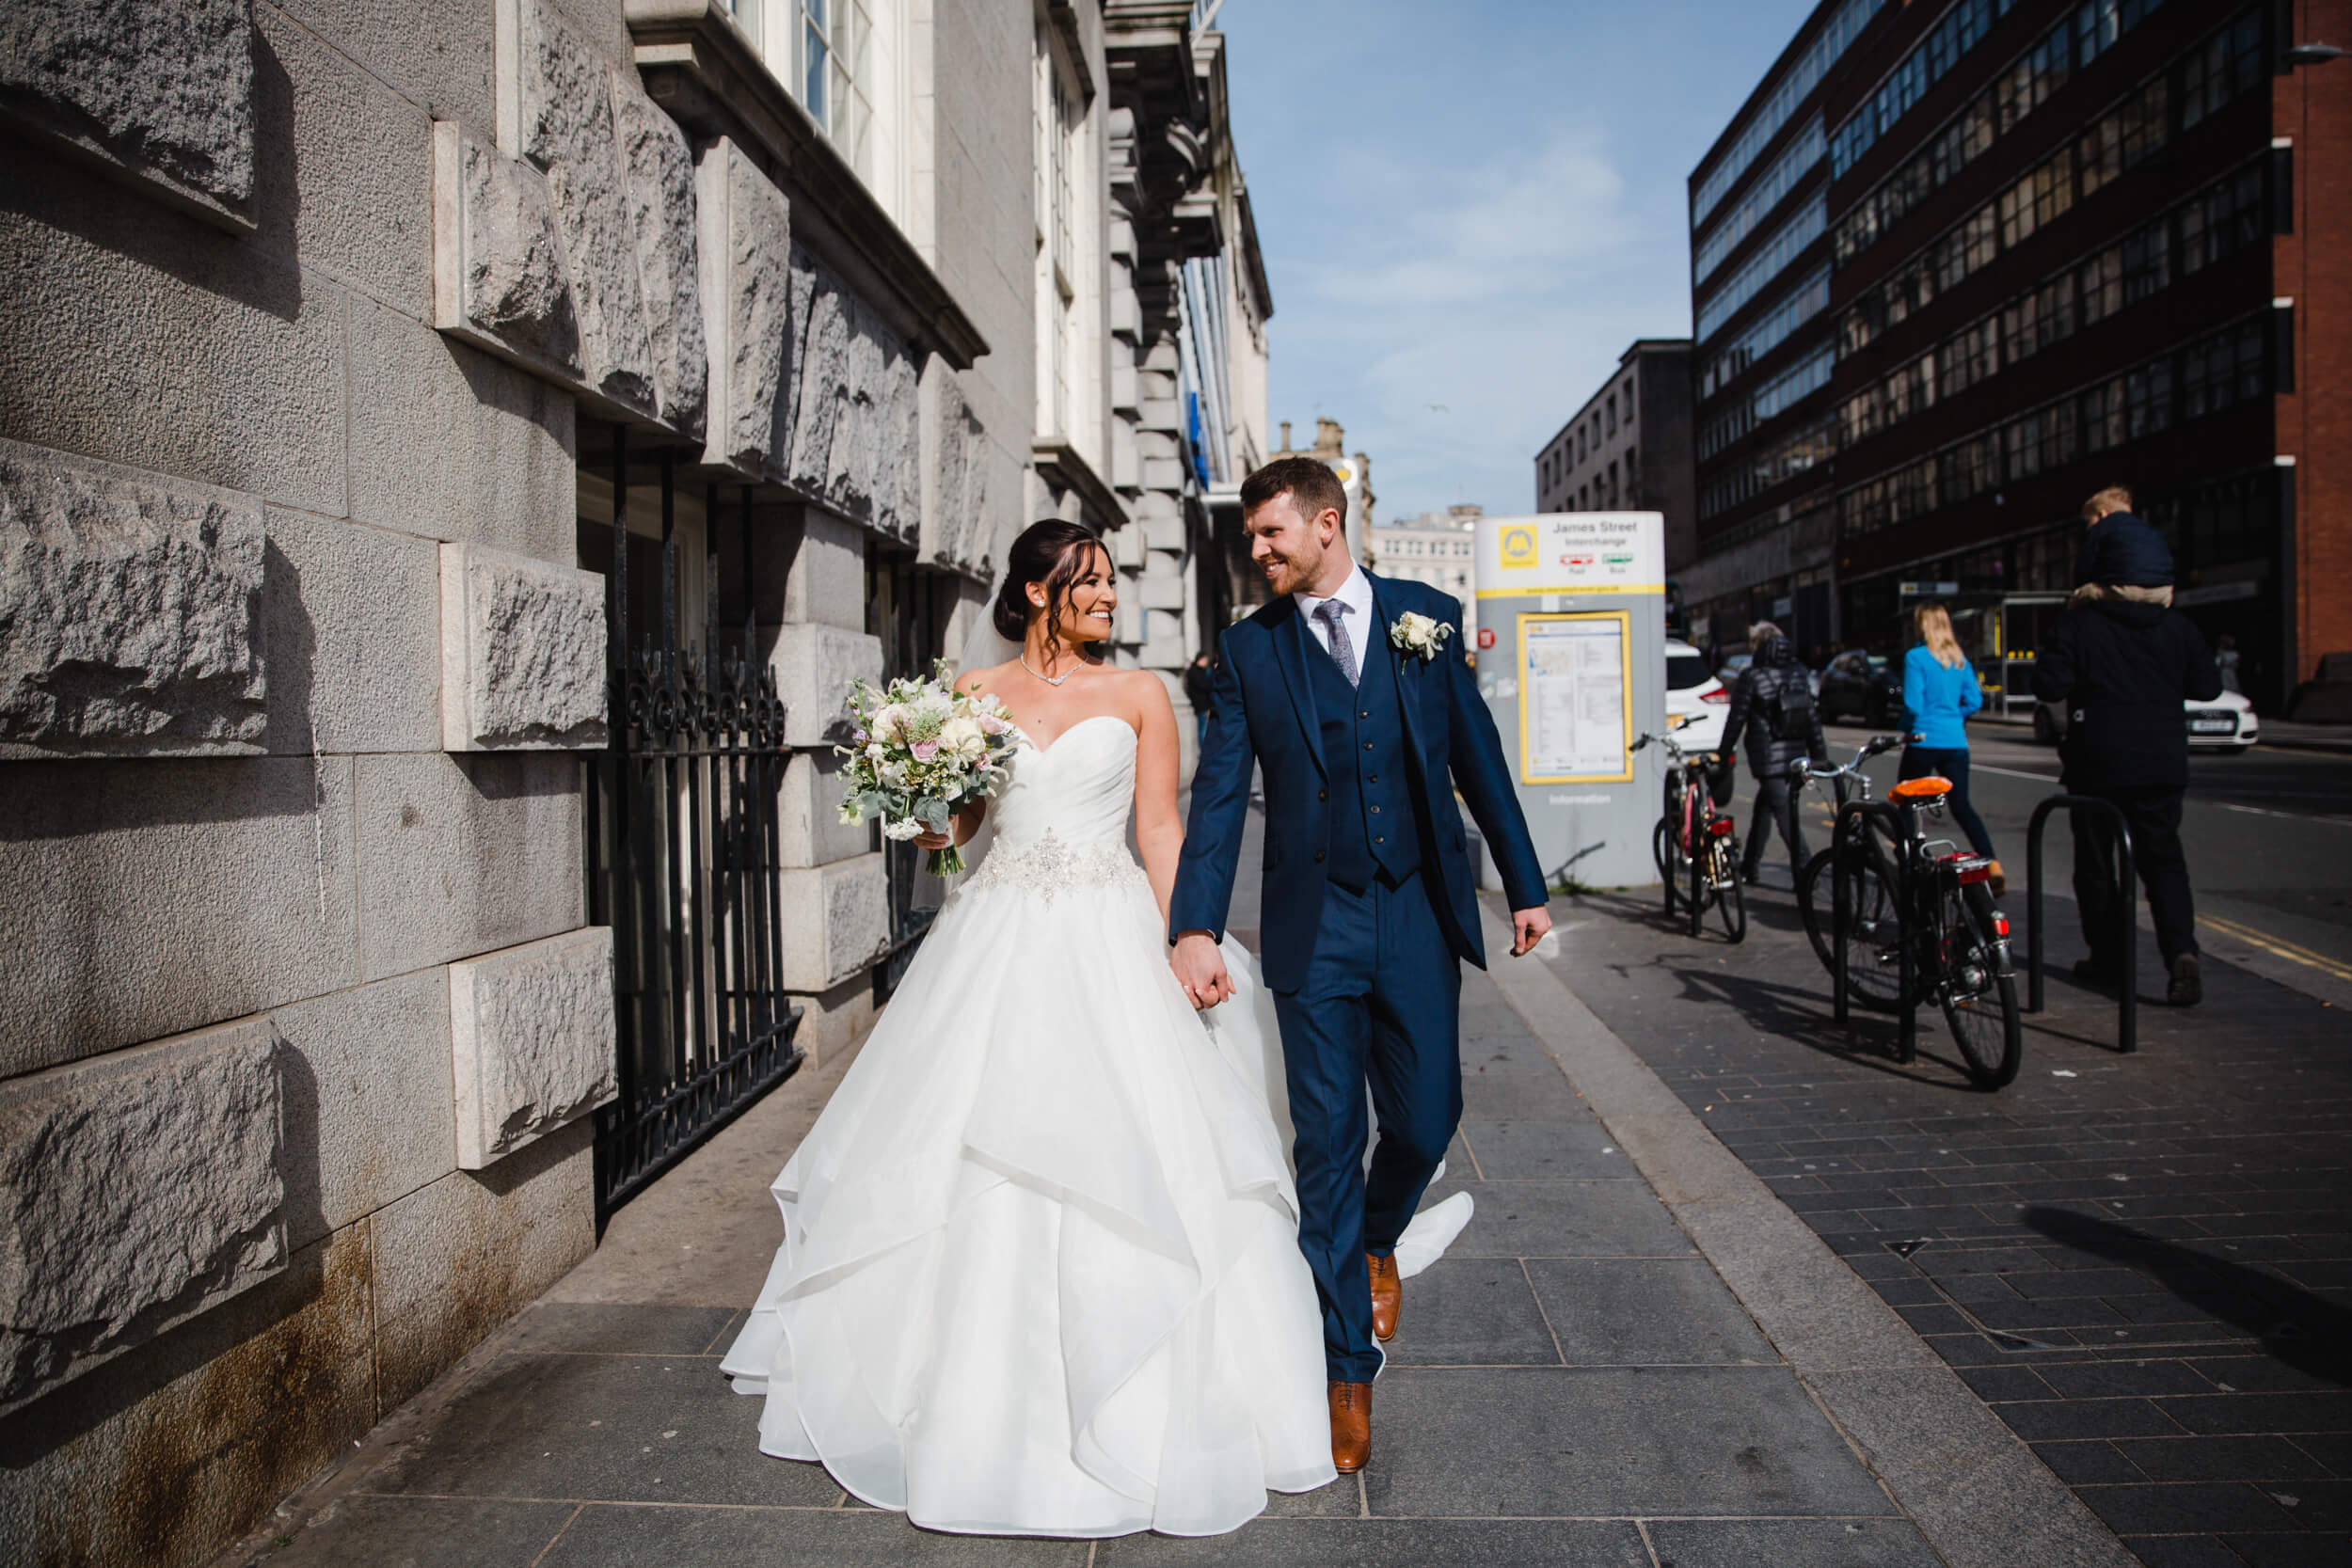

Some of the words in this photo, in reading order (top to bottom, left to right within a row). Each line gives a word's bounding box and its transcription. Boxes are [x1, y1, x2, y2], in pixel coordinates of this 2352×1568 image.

[1552, 522, 1596, 534] James
[1600, 520, 1638, 532] Street
[1565, 536, 1627, 547] Interchange
